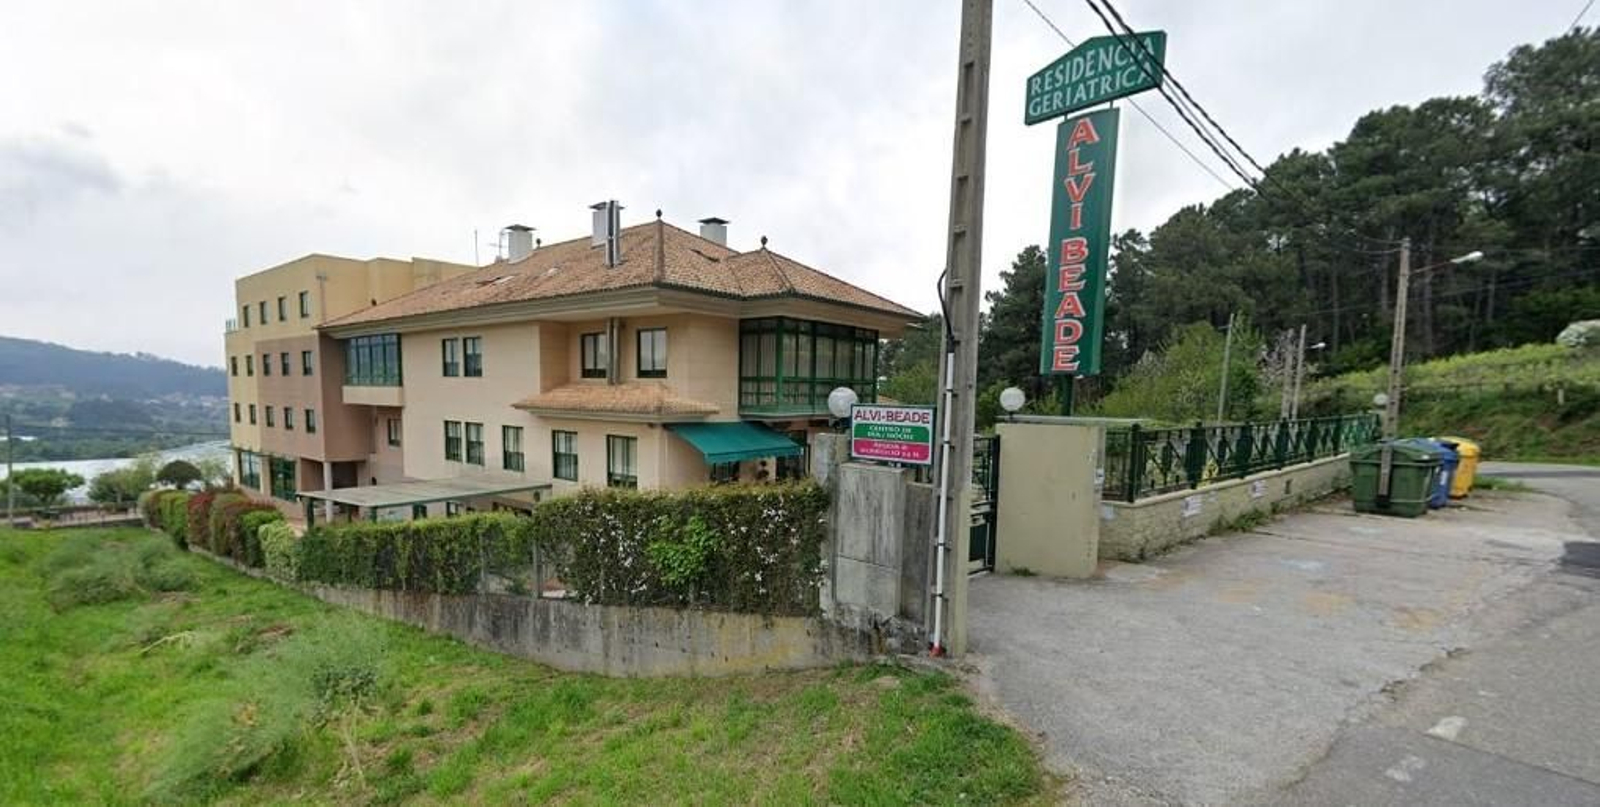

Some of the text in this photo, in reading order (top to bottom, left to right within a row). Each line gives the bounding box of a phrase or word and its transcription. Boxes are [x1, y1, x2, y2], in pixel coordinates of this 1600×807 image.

[1029, 61, 1154, 116] GERIATRICA
[1030, 37, 1154, 95] RESIDENCIA
[1052, 118, 1100, 371] ALVI BEADE
[854, 409, 930, 424] ALVI-BEADE
